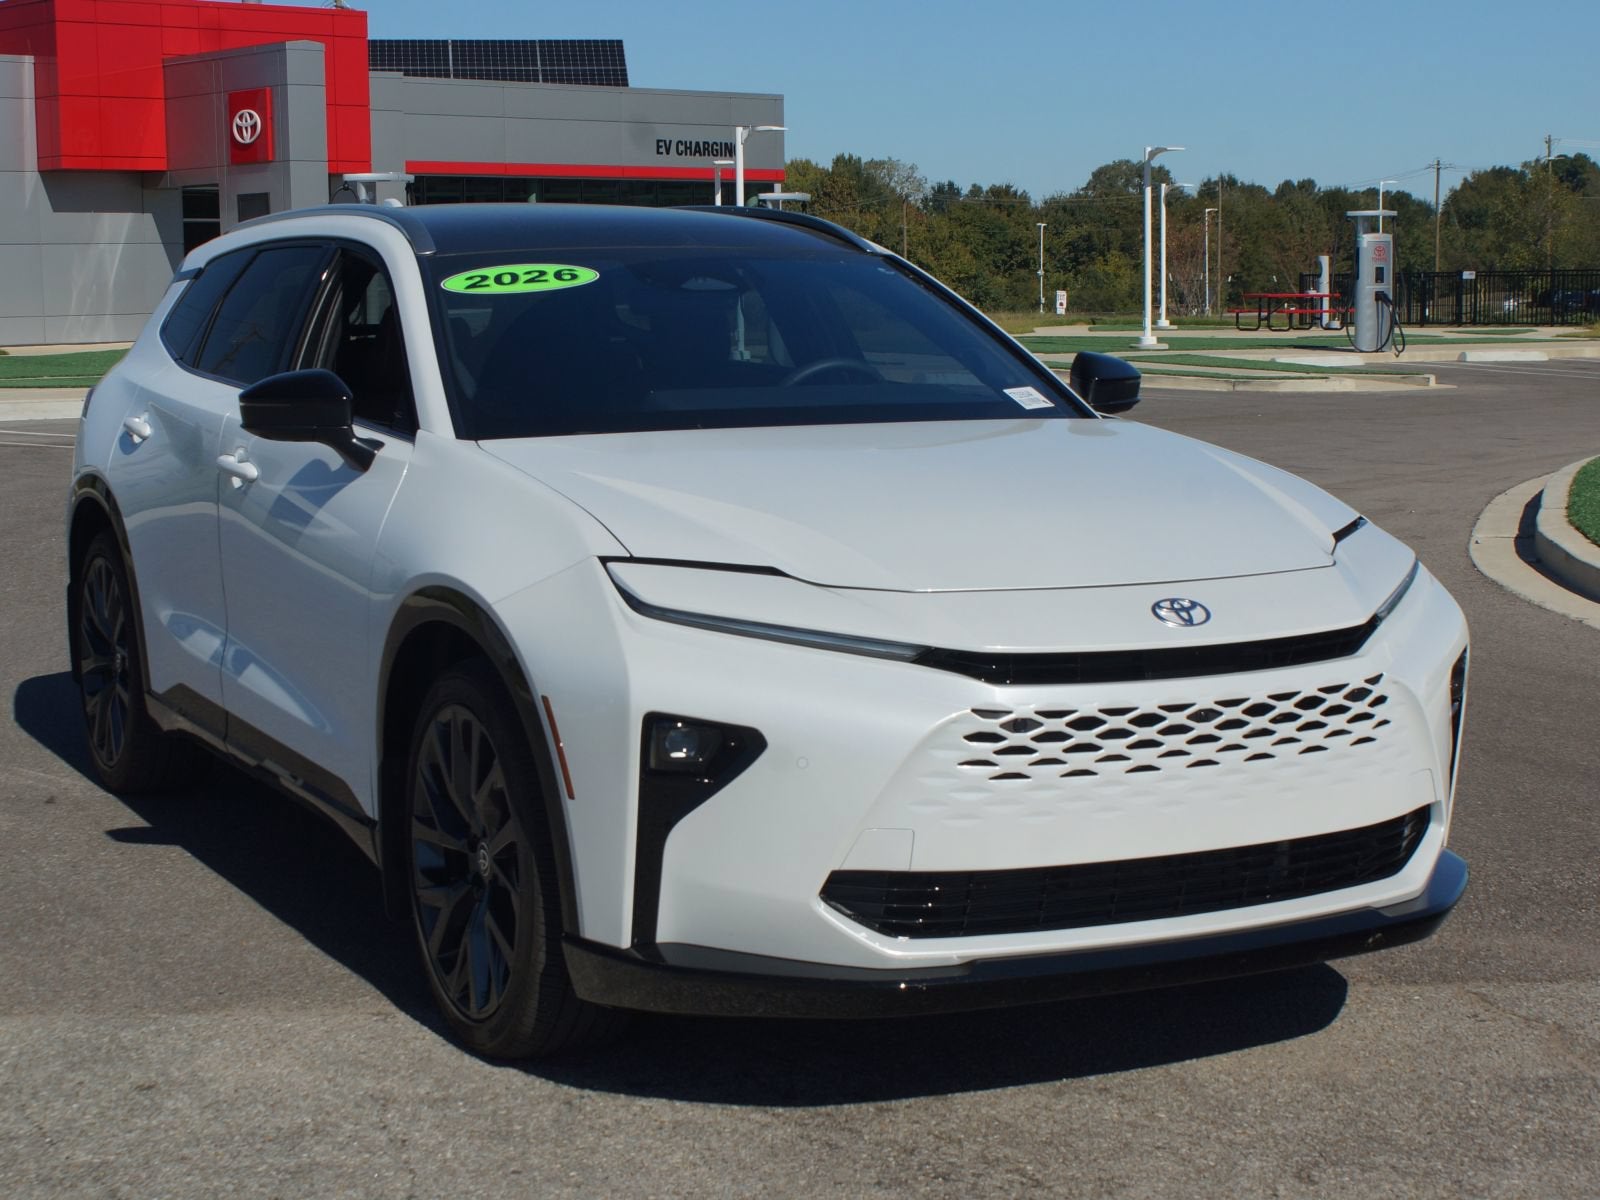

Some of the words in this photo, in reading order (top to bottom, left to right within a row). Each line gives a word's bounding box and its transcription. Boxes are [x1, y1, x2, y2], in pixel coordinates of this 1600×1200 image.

[656, 139, 672, 155] EV
[676, 140, 736, 158] CHARGIN
[464, 268, 579, 290] 2026
